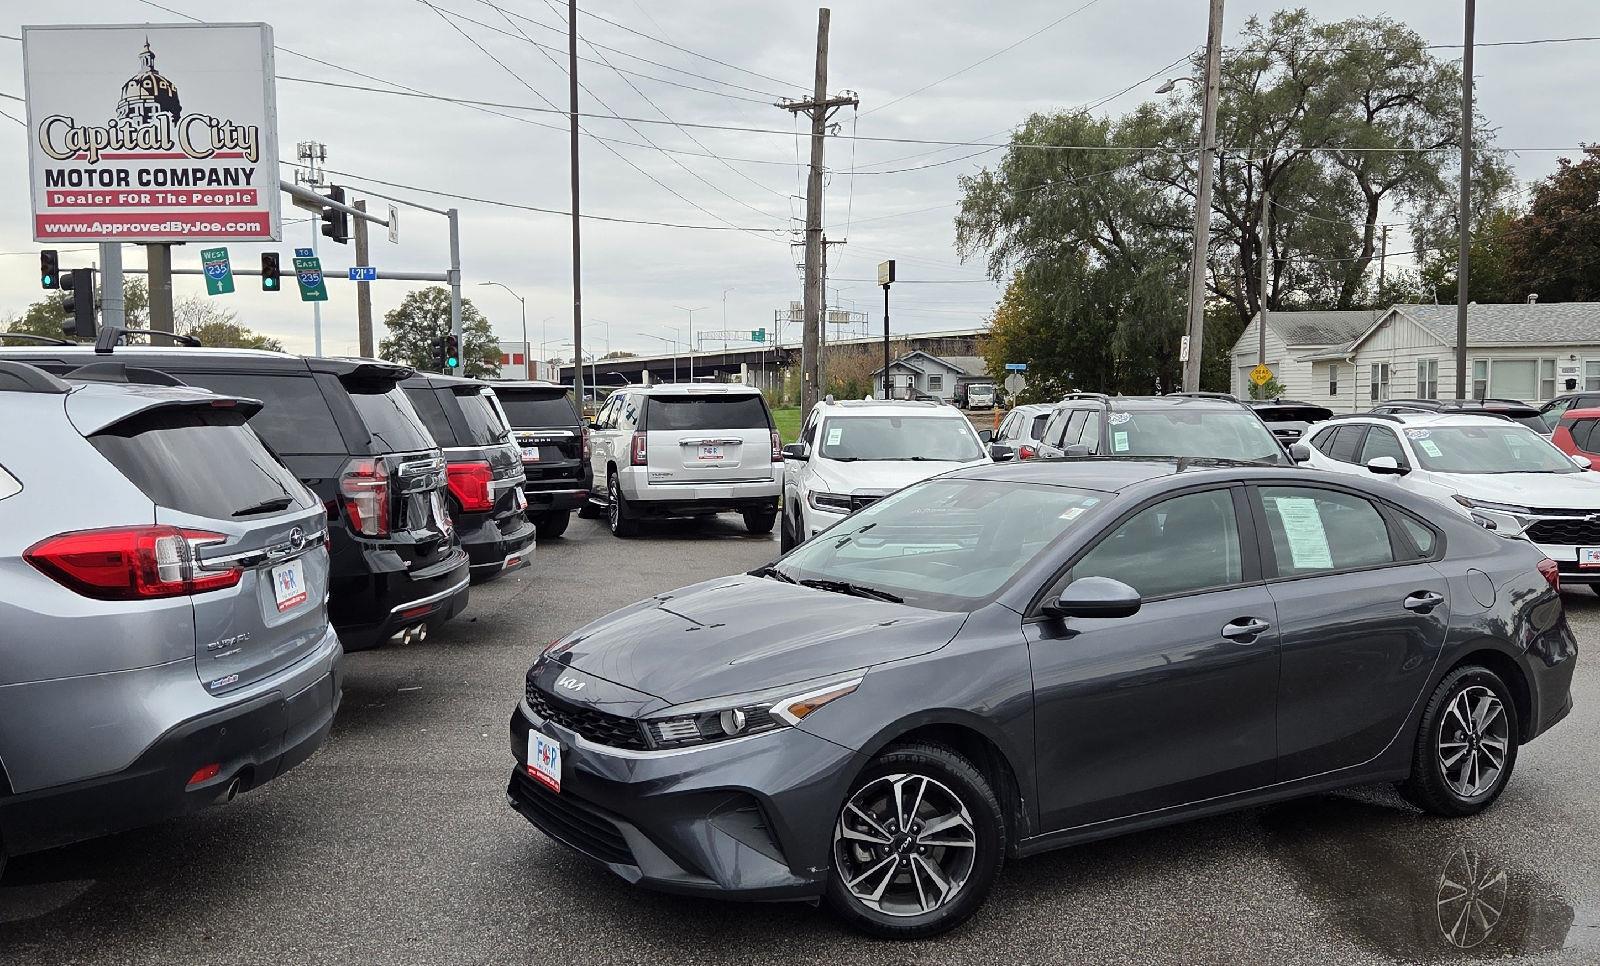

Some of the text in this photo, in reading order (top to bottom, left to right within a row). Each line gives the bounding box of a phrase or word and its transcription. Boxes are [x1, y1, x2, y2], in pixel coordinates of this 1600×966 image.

[39, 113, 259, 164] Capital City
[45, 167, 255, 187] MOTOR COMPANY
[54, 192, 251, 207] Dealer FOR The People
[45, 221, 261, 235] www.ApprovedByJoe.com
[203, 250, 225, 260] WEST
[208, 264, 227, 275] 235
[296, 259, 318, 268] EAST
[301, 273, 320, 282] 235
